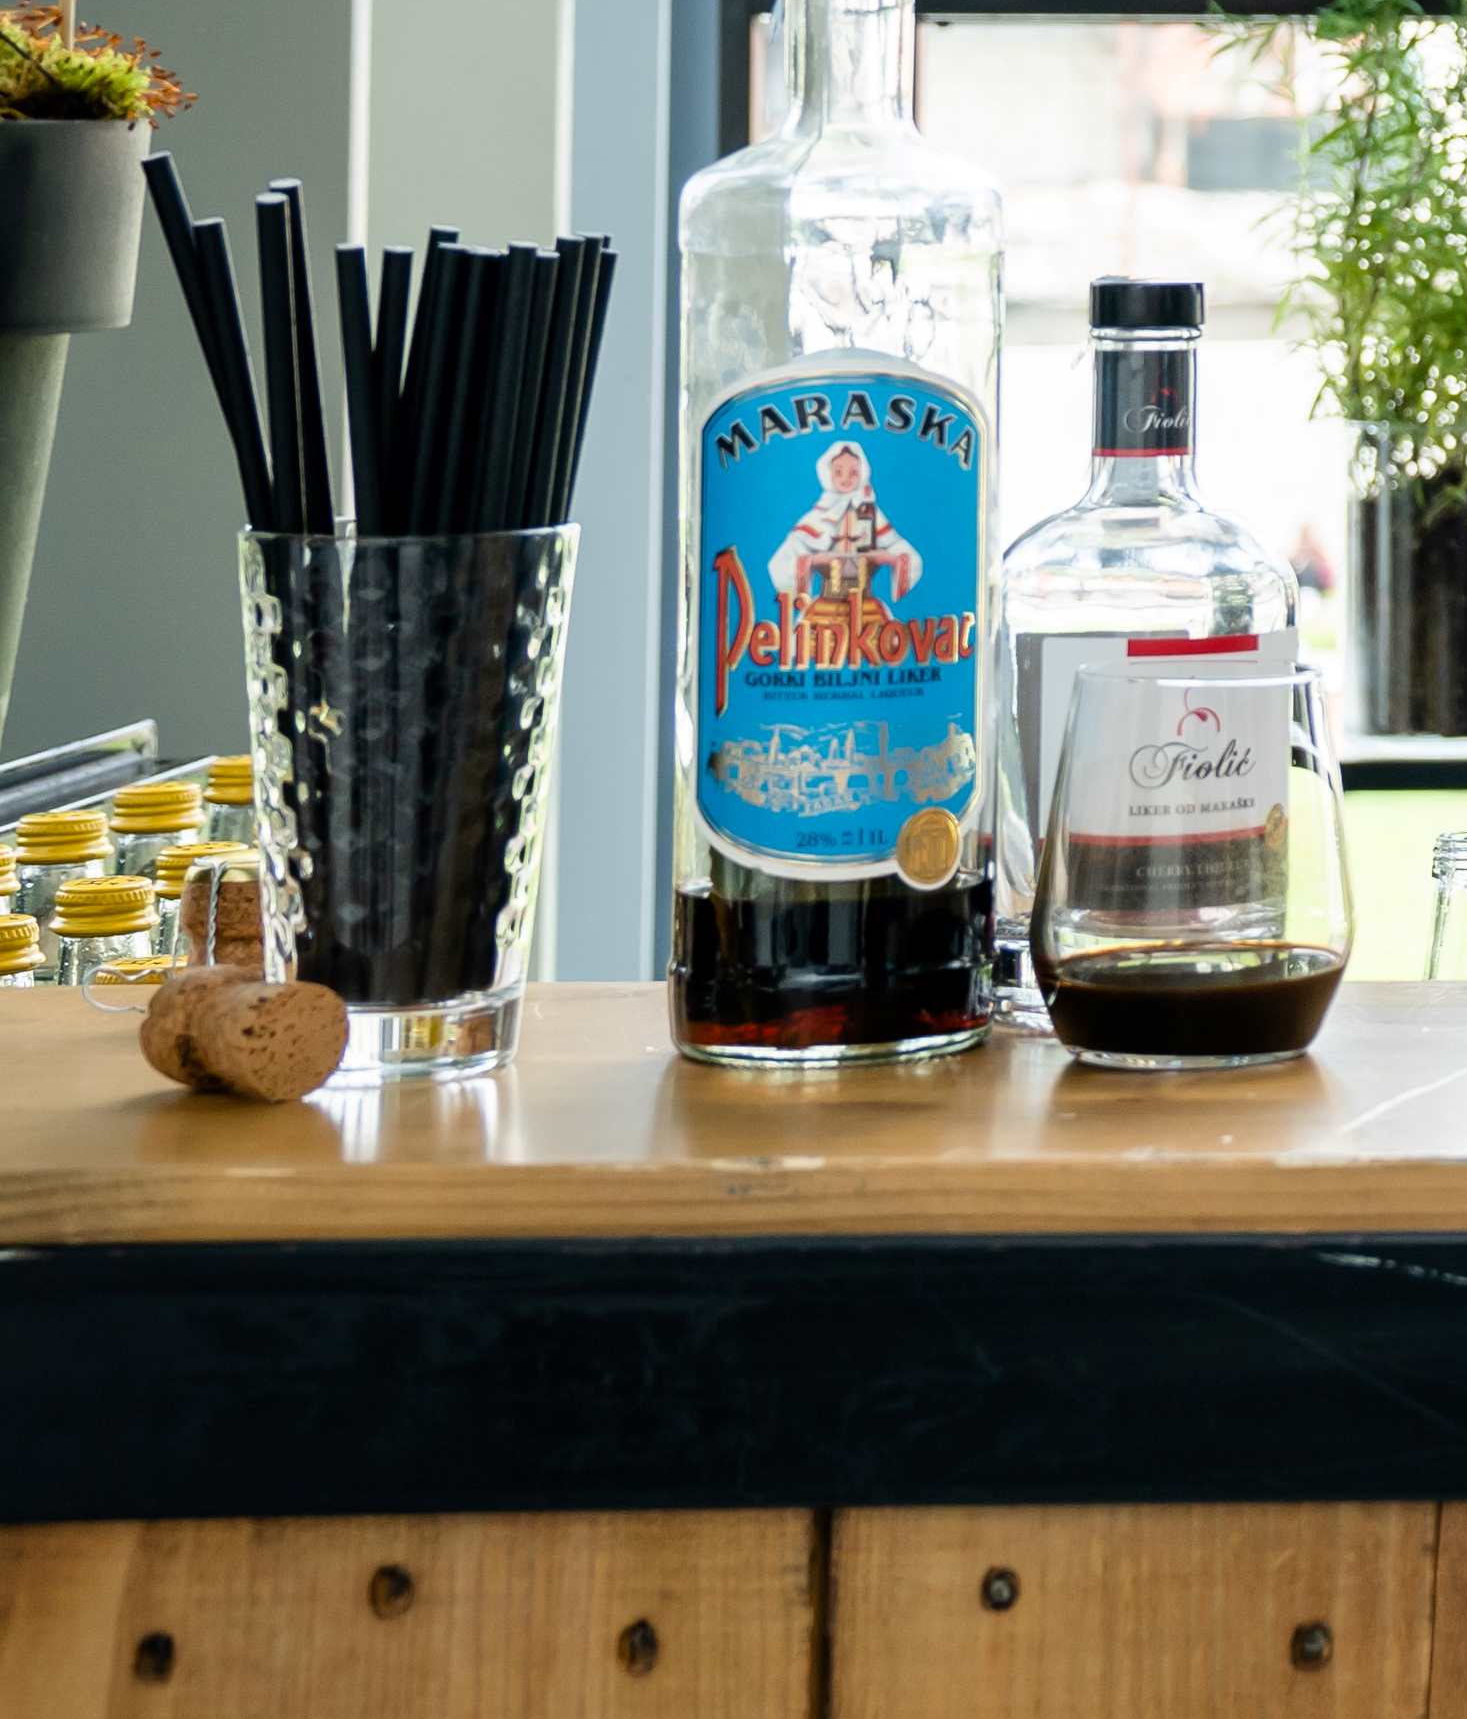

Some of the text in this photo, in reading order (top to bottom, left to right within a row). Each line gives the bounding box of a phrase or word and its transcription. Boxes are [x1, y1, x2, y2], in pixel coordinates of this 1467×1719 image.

[714, 390, 977, 471] MARASKA
[713, 545, 976, 718] Pelinkovac
[744, 666, 942, 687] GORKI BILJNI LIKER
[1128, 738, 1256, 790] Fiolić
[1128, 803, 1172, 817] LIKER
[1175, 803, 1197, 815] OD
